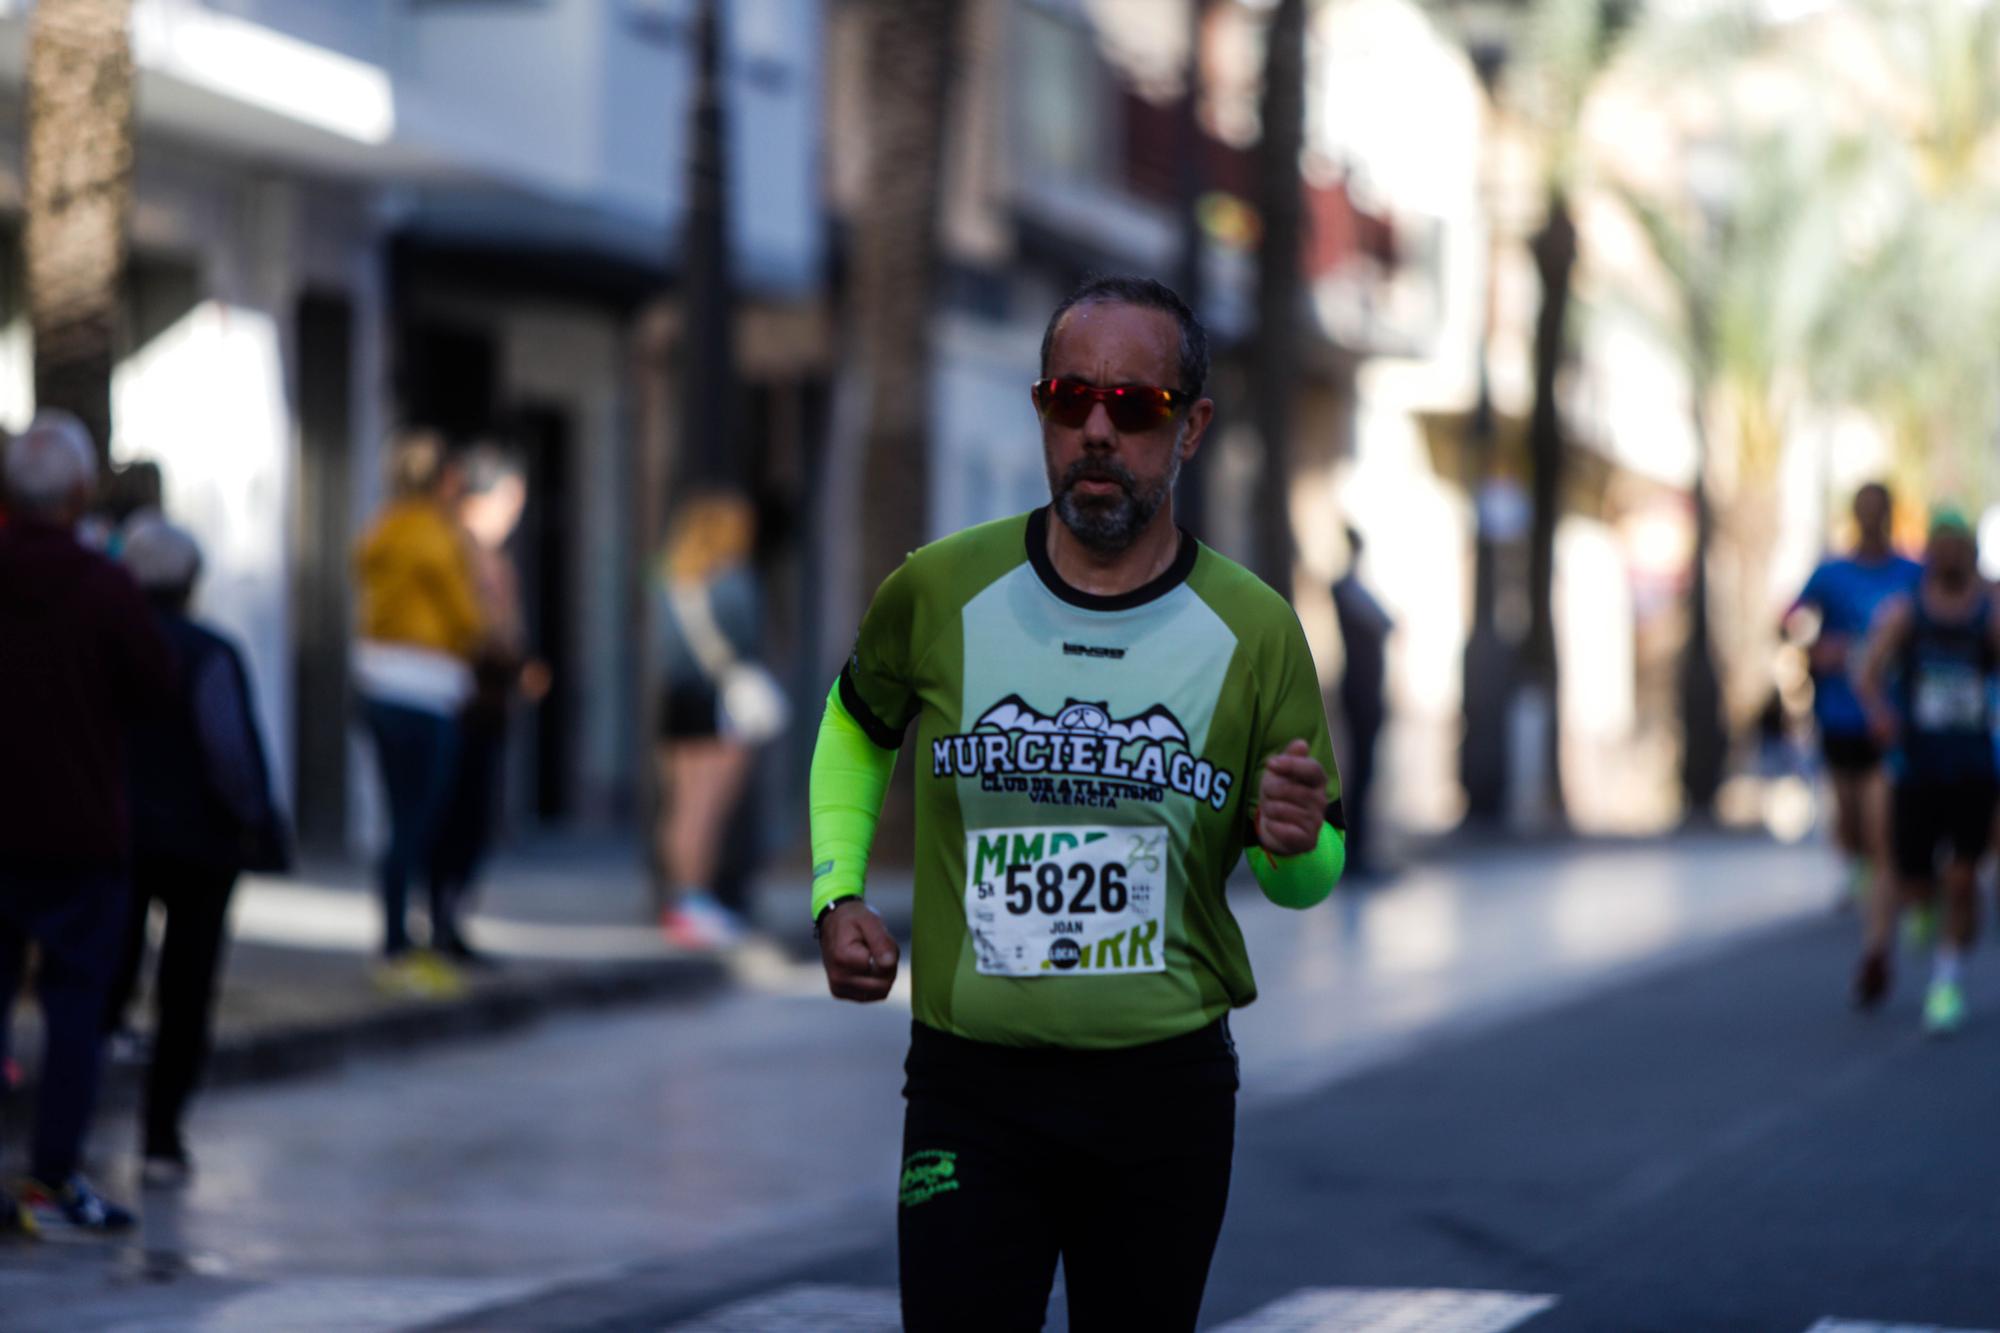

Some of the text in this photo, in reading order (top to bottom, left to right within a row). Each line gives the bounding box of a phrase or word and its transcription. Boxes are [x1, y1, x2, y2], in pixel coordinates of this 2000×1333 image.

[932, 732, 1234, 812] MURCIELAGOS
[981, 776, 1165, 804] CLUB DE ATLETISMO
[1028, 791, 1118, 810] VALENCIA
[1005, 861, 1128, 916] 5826
[1049, 920, 1084, 936] JOAN
